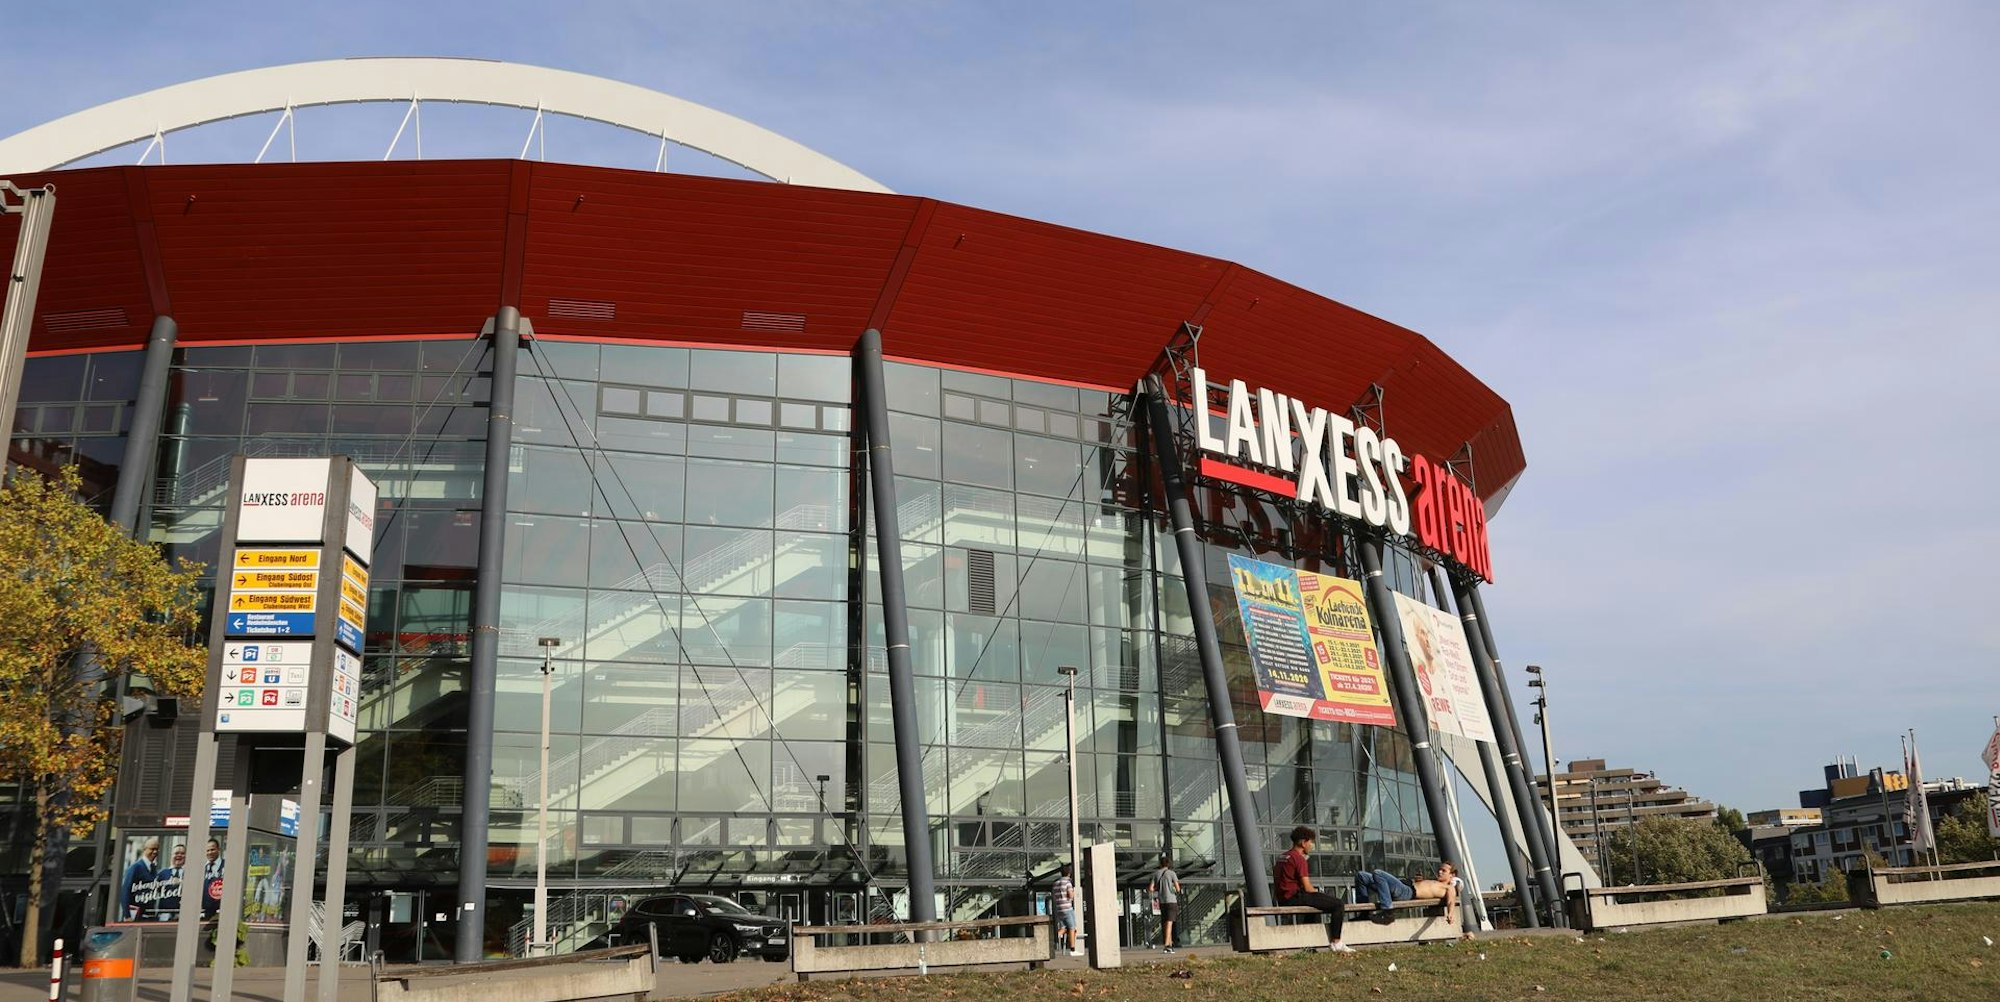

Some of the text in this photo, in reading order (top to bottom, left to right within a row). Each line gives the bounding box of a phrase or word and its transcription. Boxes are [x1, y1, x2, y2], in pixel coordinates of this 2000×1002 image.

[1193, 367, 1493, 584] LANXESS arena
[243, 492, 324, 506] LANXESS arena
[258, 554, 307, 563] Eingang Nord
[256, 573, 313, 582] Eingang Südost
[249, 594, 311, 603] Eingang Südwest
[244, 651, 256, 659] P1
[242, 673, 254, 681] P2
[263, 696, 276, 704] P4
[1431, 698, 1452, 714] REWE
[747, 875, 776, 883] Eingang
[134, 884, 183, 904] visit.koel
